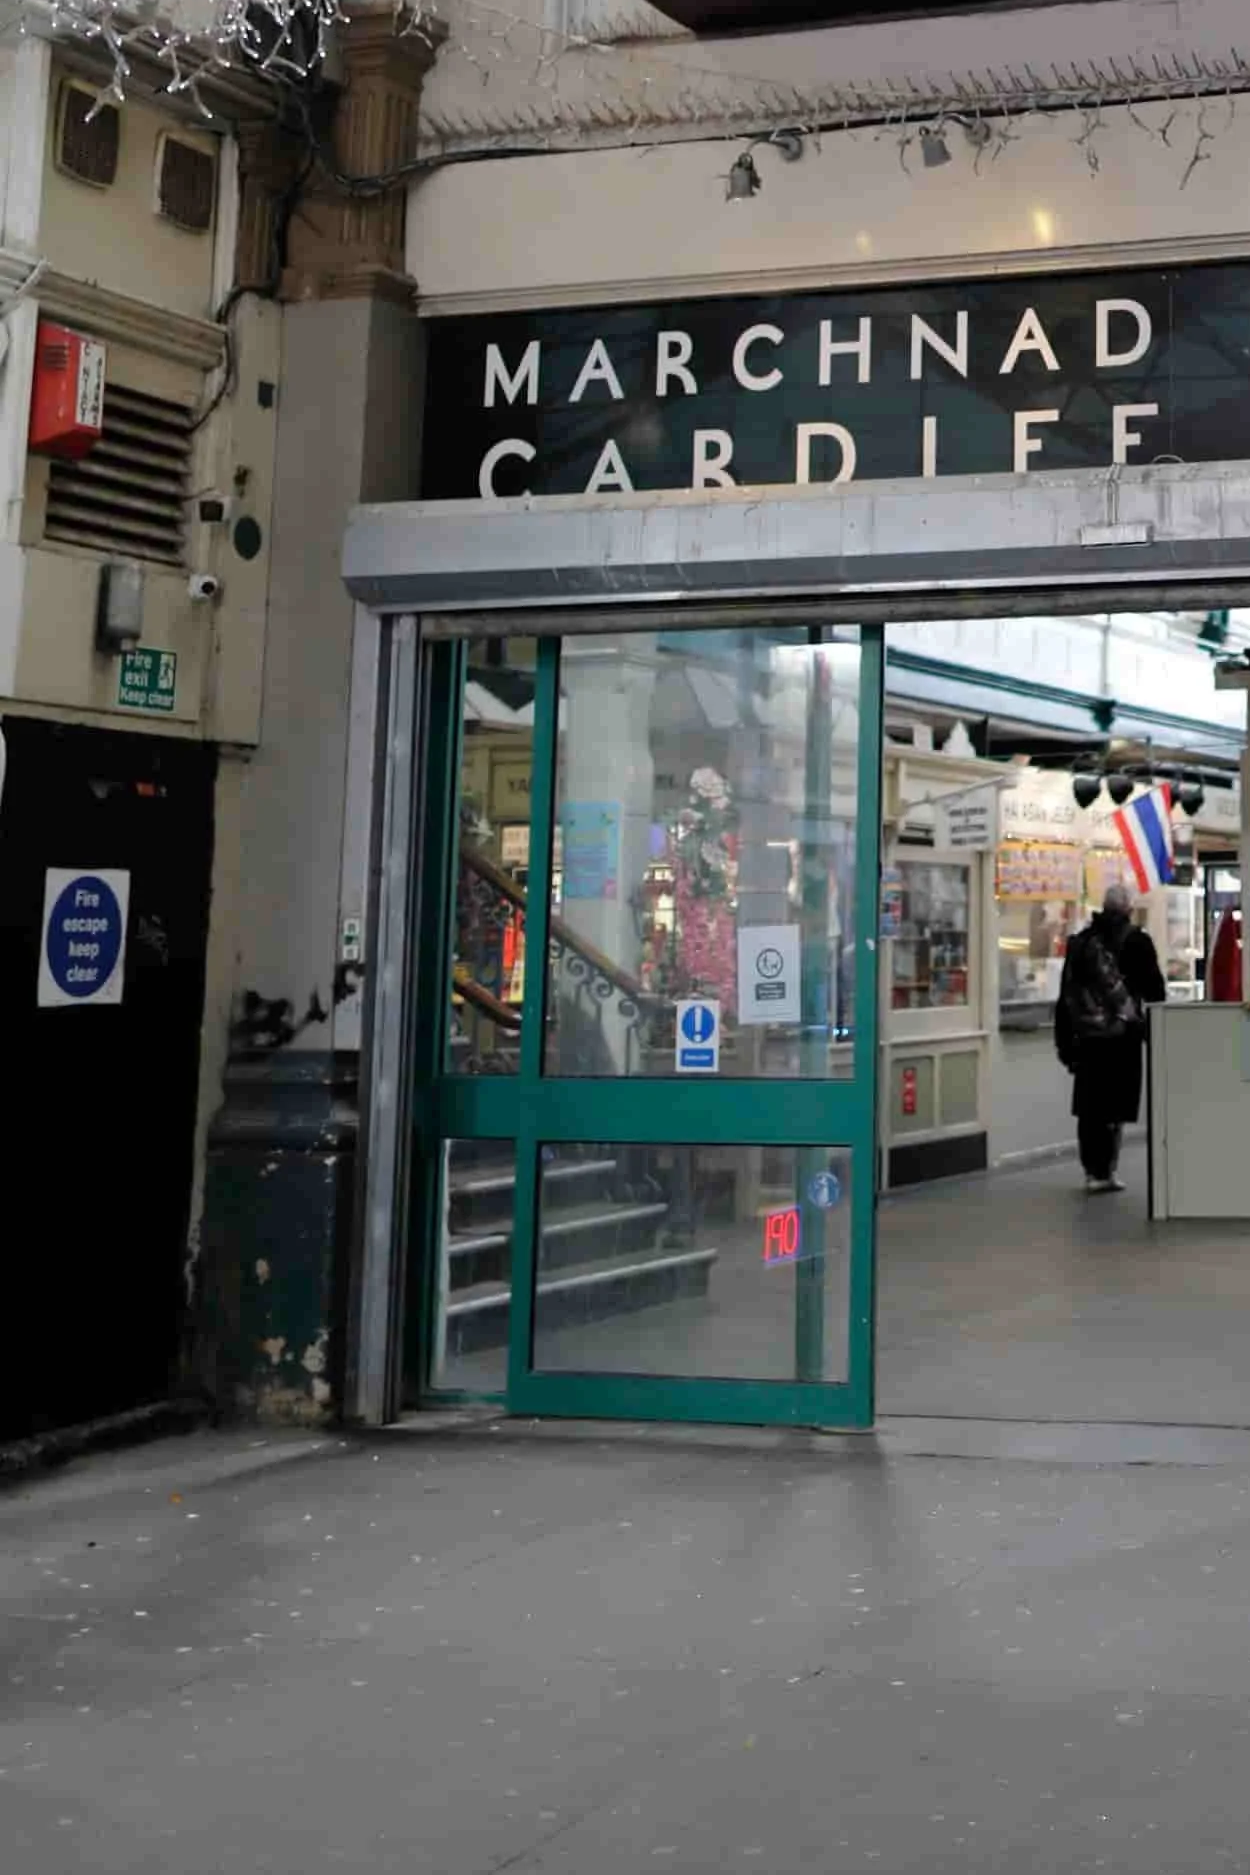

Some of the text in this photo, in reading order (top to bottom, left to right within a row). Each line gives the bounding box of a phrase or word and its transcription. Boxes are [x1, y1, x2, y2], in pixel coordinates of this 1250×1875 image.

[482, 298, 1153, 408] MARCHNAD
[478, 402, 1160, 501] CARDIFF
[75, 889, 100, 908] Fire
[62, 917, 108, 935] escape
[68, 940, 100, 960] keep
[65, 964, 99, 983] clear
